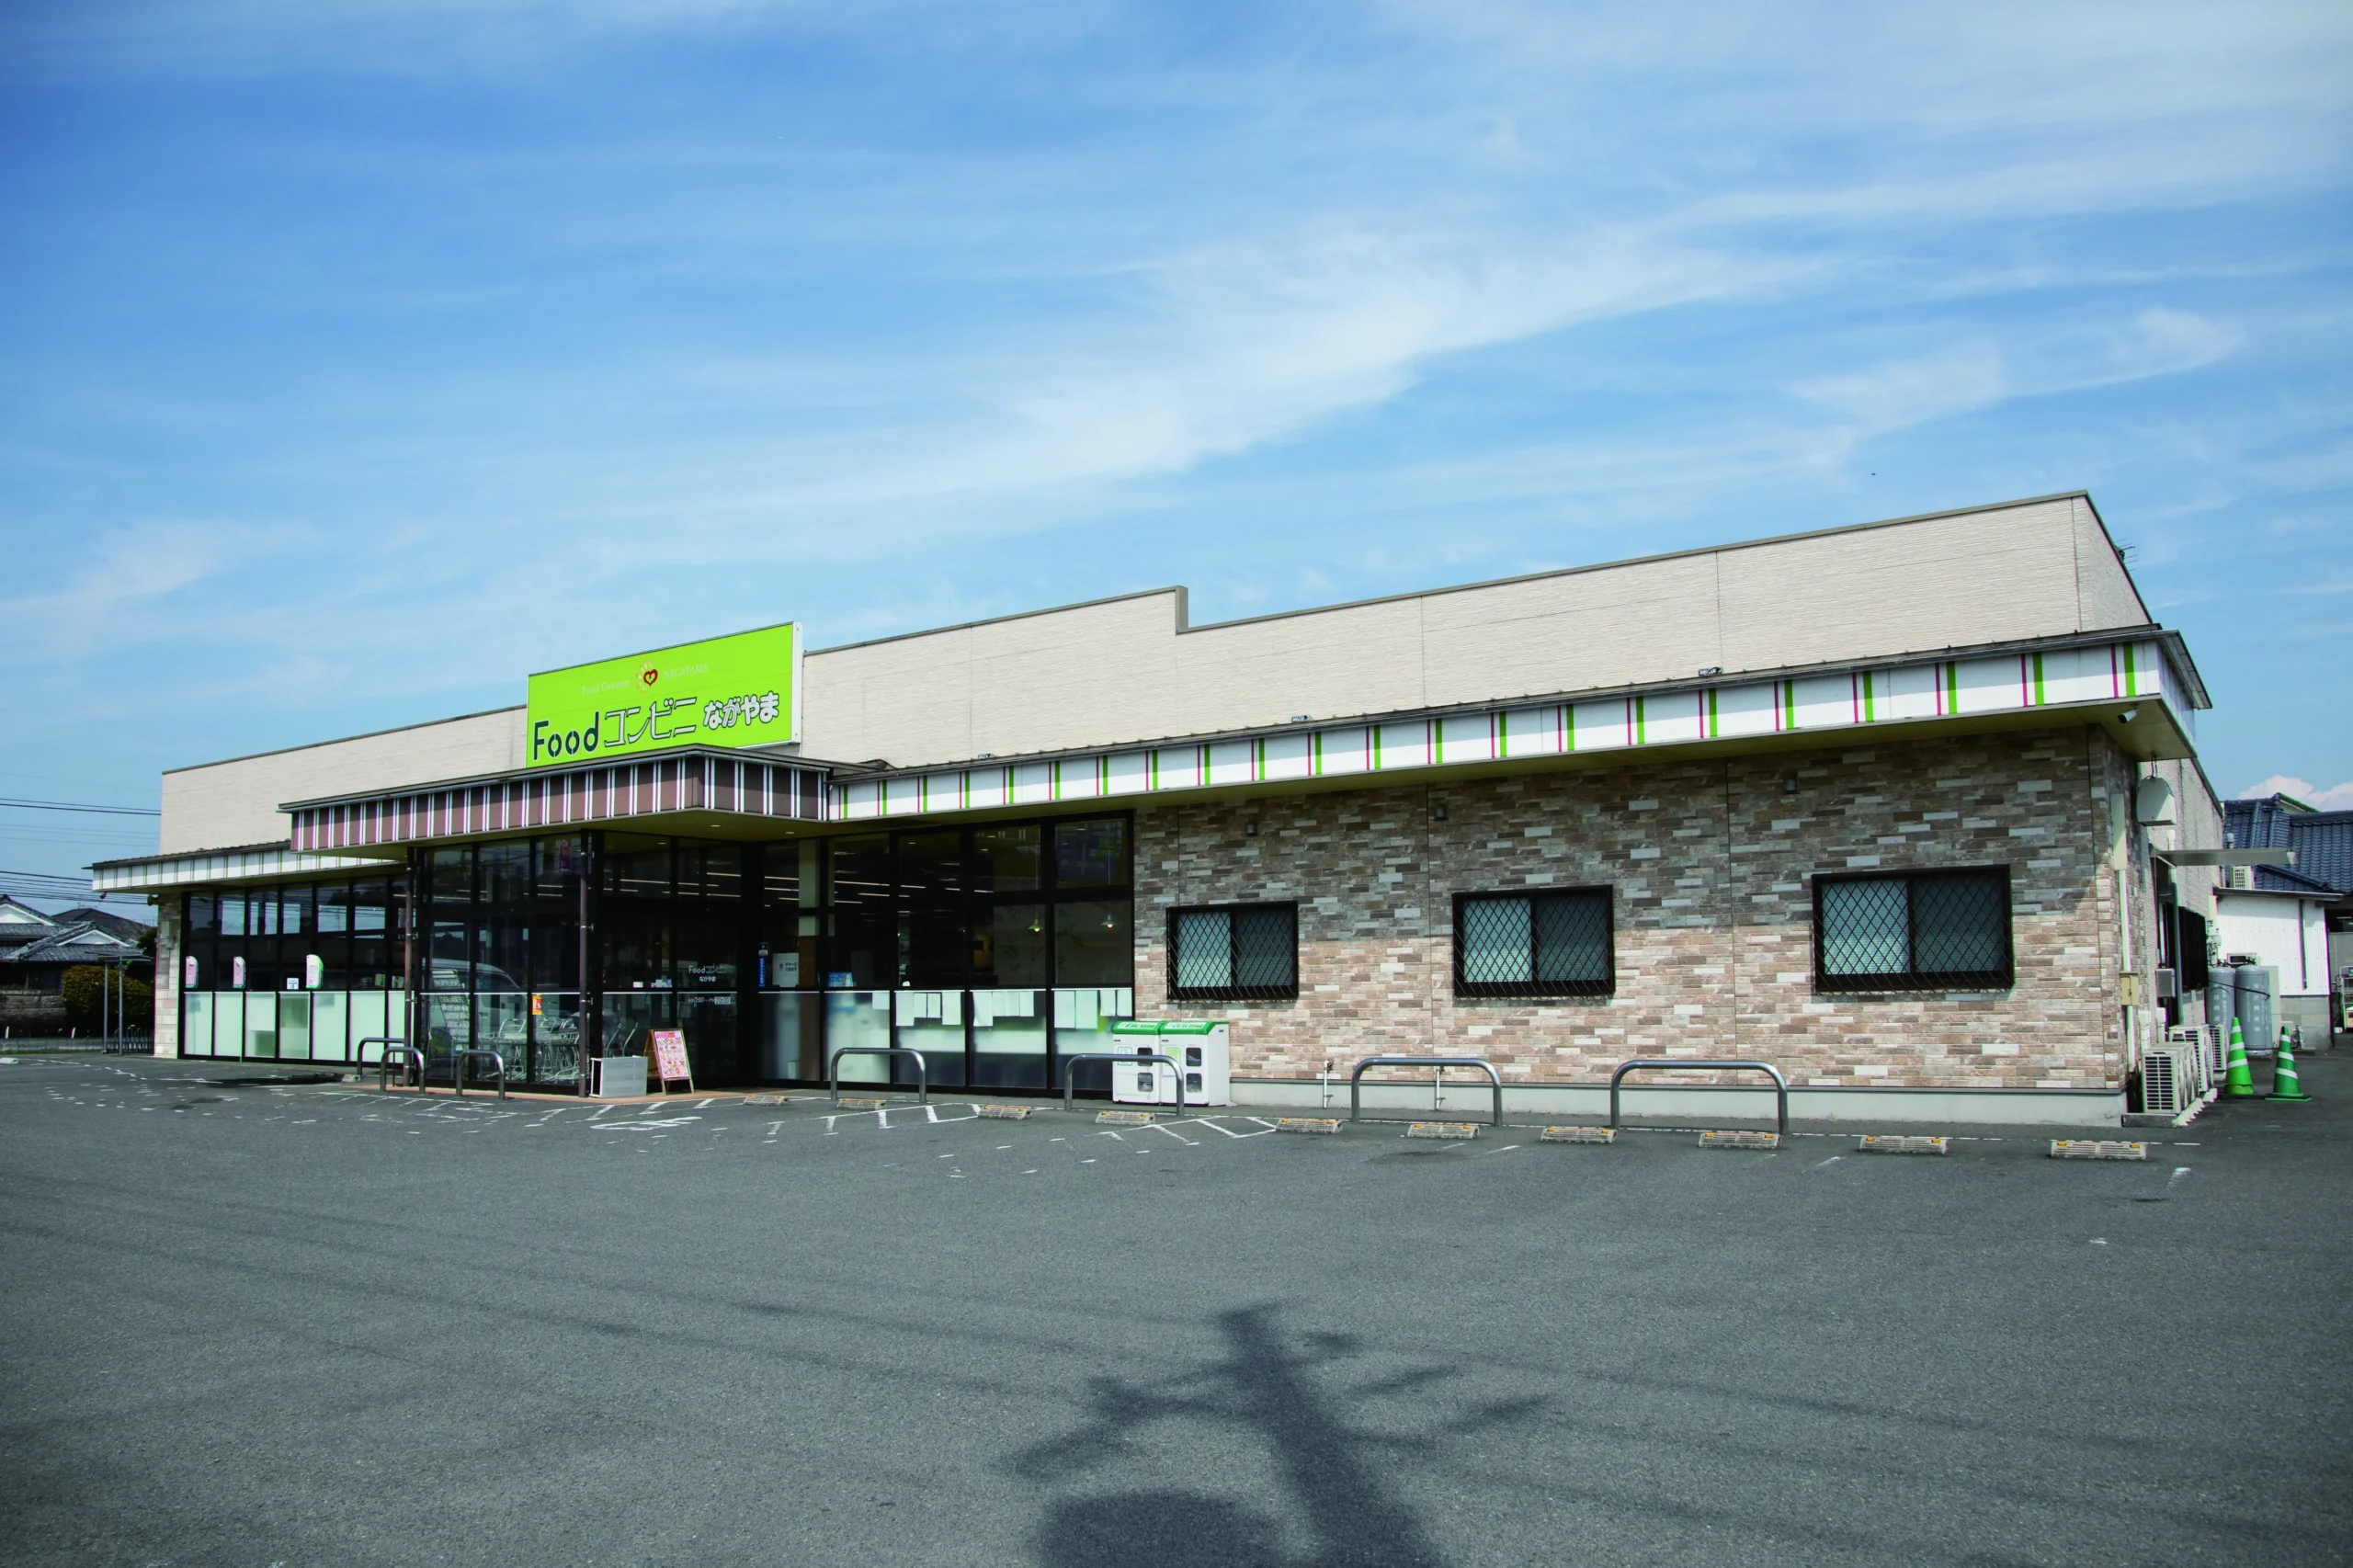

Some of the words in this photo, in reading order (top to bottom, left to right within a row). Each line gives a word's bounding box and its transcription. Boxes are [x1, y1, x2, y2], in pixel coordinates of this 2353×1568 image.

[582, 682, 599, 696] Food
[664, 663, 709, 680] NAGAYAMA
[532, 710, 599, 762] Food
[603, 696, 698, 748] コンビニ
[703, 690, 780, 731] ながやま
[688, 965, 706, 974] Food
